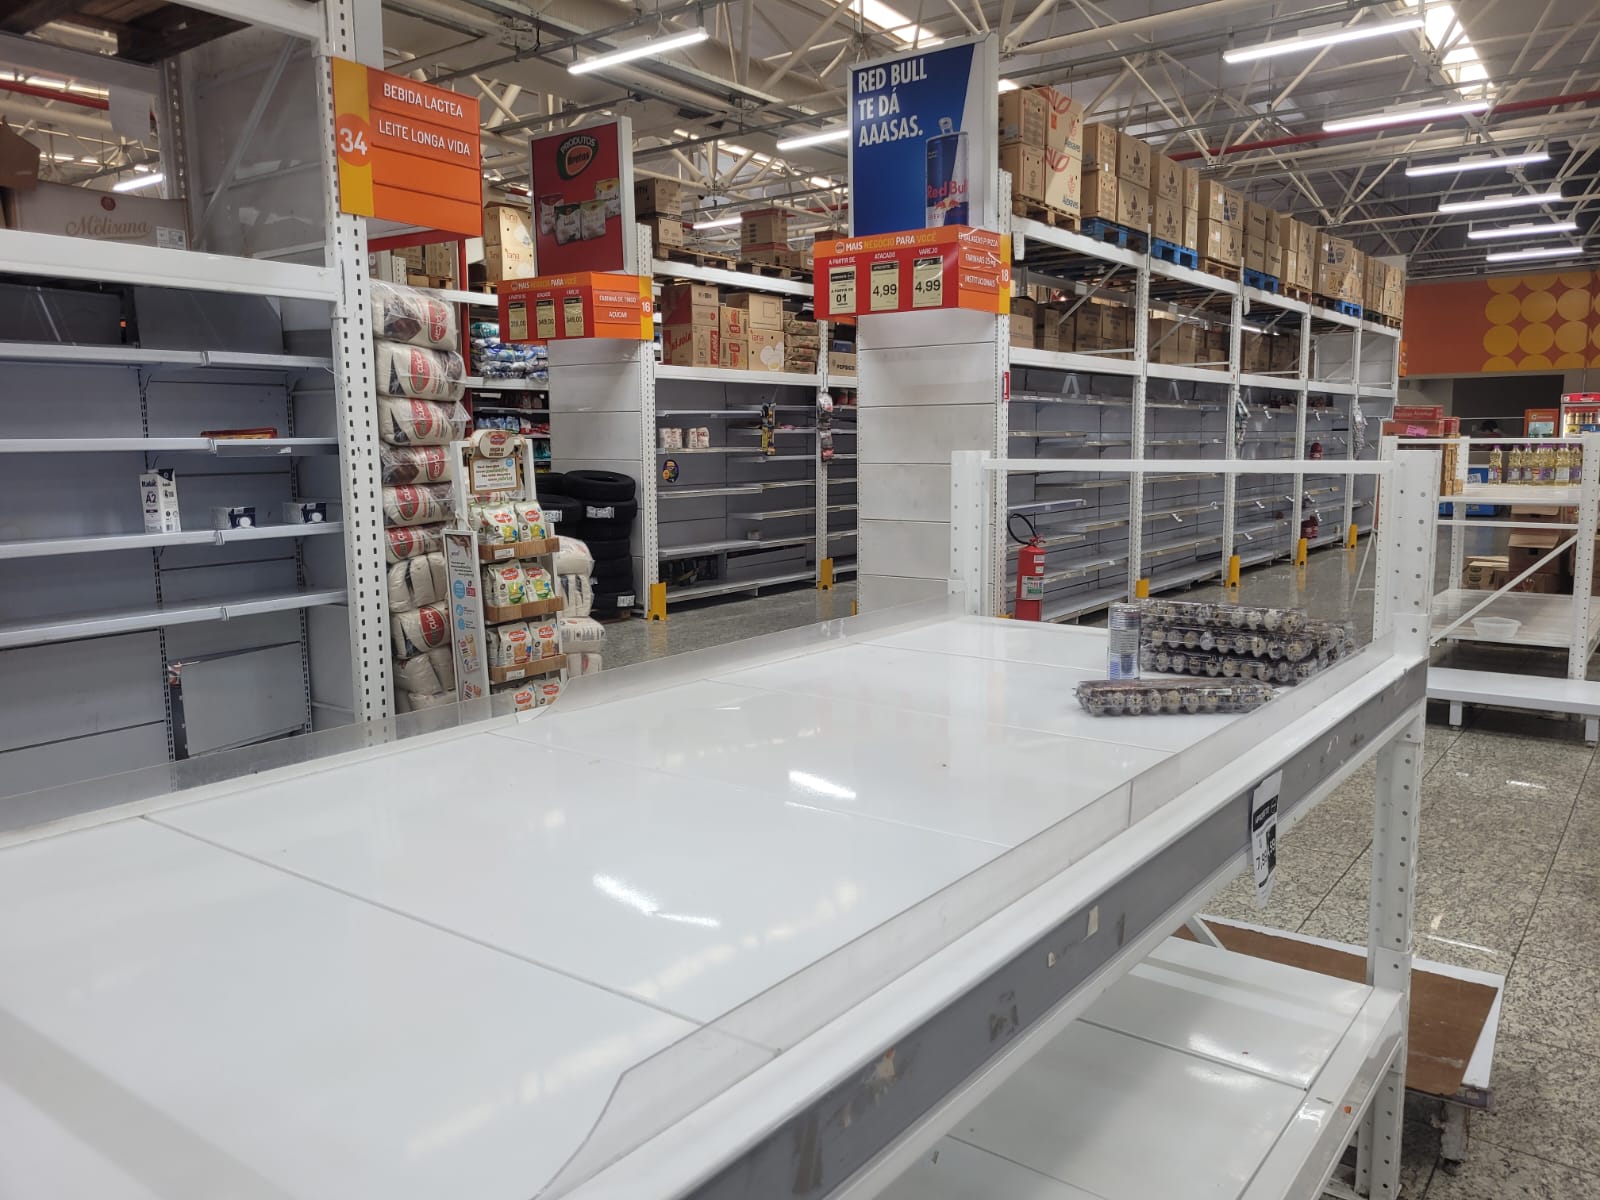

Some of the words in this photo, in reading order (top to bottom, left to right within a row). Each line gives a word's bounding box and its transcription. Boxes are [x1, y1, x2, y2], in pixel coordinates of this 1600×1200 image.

[858, 68, 886, 94] RED
[891, 58, 927, 86] BULL
[384, 83, 422, 105] BEBIDA
[425, 95, 463, 118] LACTEA
[858, 98, 874, 120] TE
[878, 87, 900, 117] DÁ
[379, 120, 409, 140] LEITE
[411, 130, 445, 149] LONGA
[447, 139, 471, 156] VIDA
[858, 115, 923, 147] AAASAS.
[339, 128, 367, 155] 34
[560, 136, 597, 154] PRODUTOS
[928, 181, 947, 199] Red
[845, 241, 863, 252] MAIS
[864, 237, 894, 249] NEGÓCIO
[896, 235, 915, 246] PARA
[1001, 269, 1009, 282] 18
[873, 284, 897, 298] 4,99
[915, 280, 941, 294] 4,99
[836, 293, 847, 303] 01
[608, 309, 628, 319] AÇÚCAR
[642, 301, 650, 313] 16
[146, 493, 156, 503] A2
